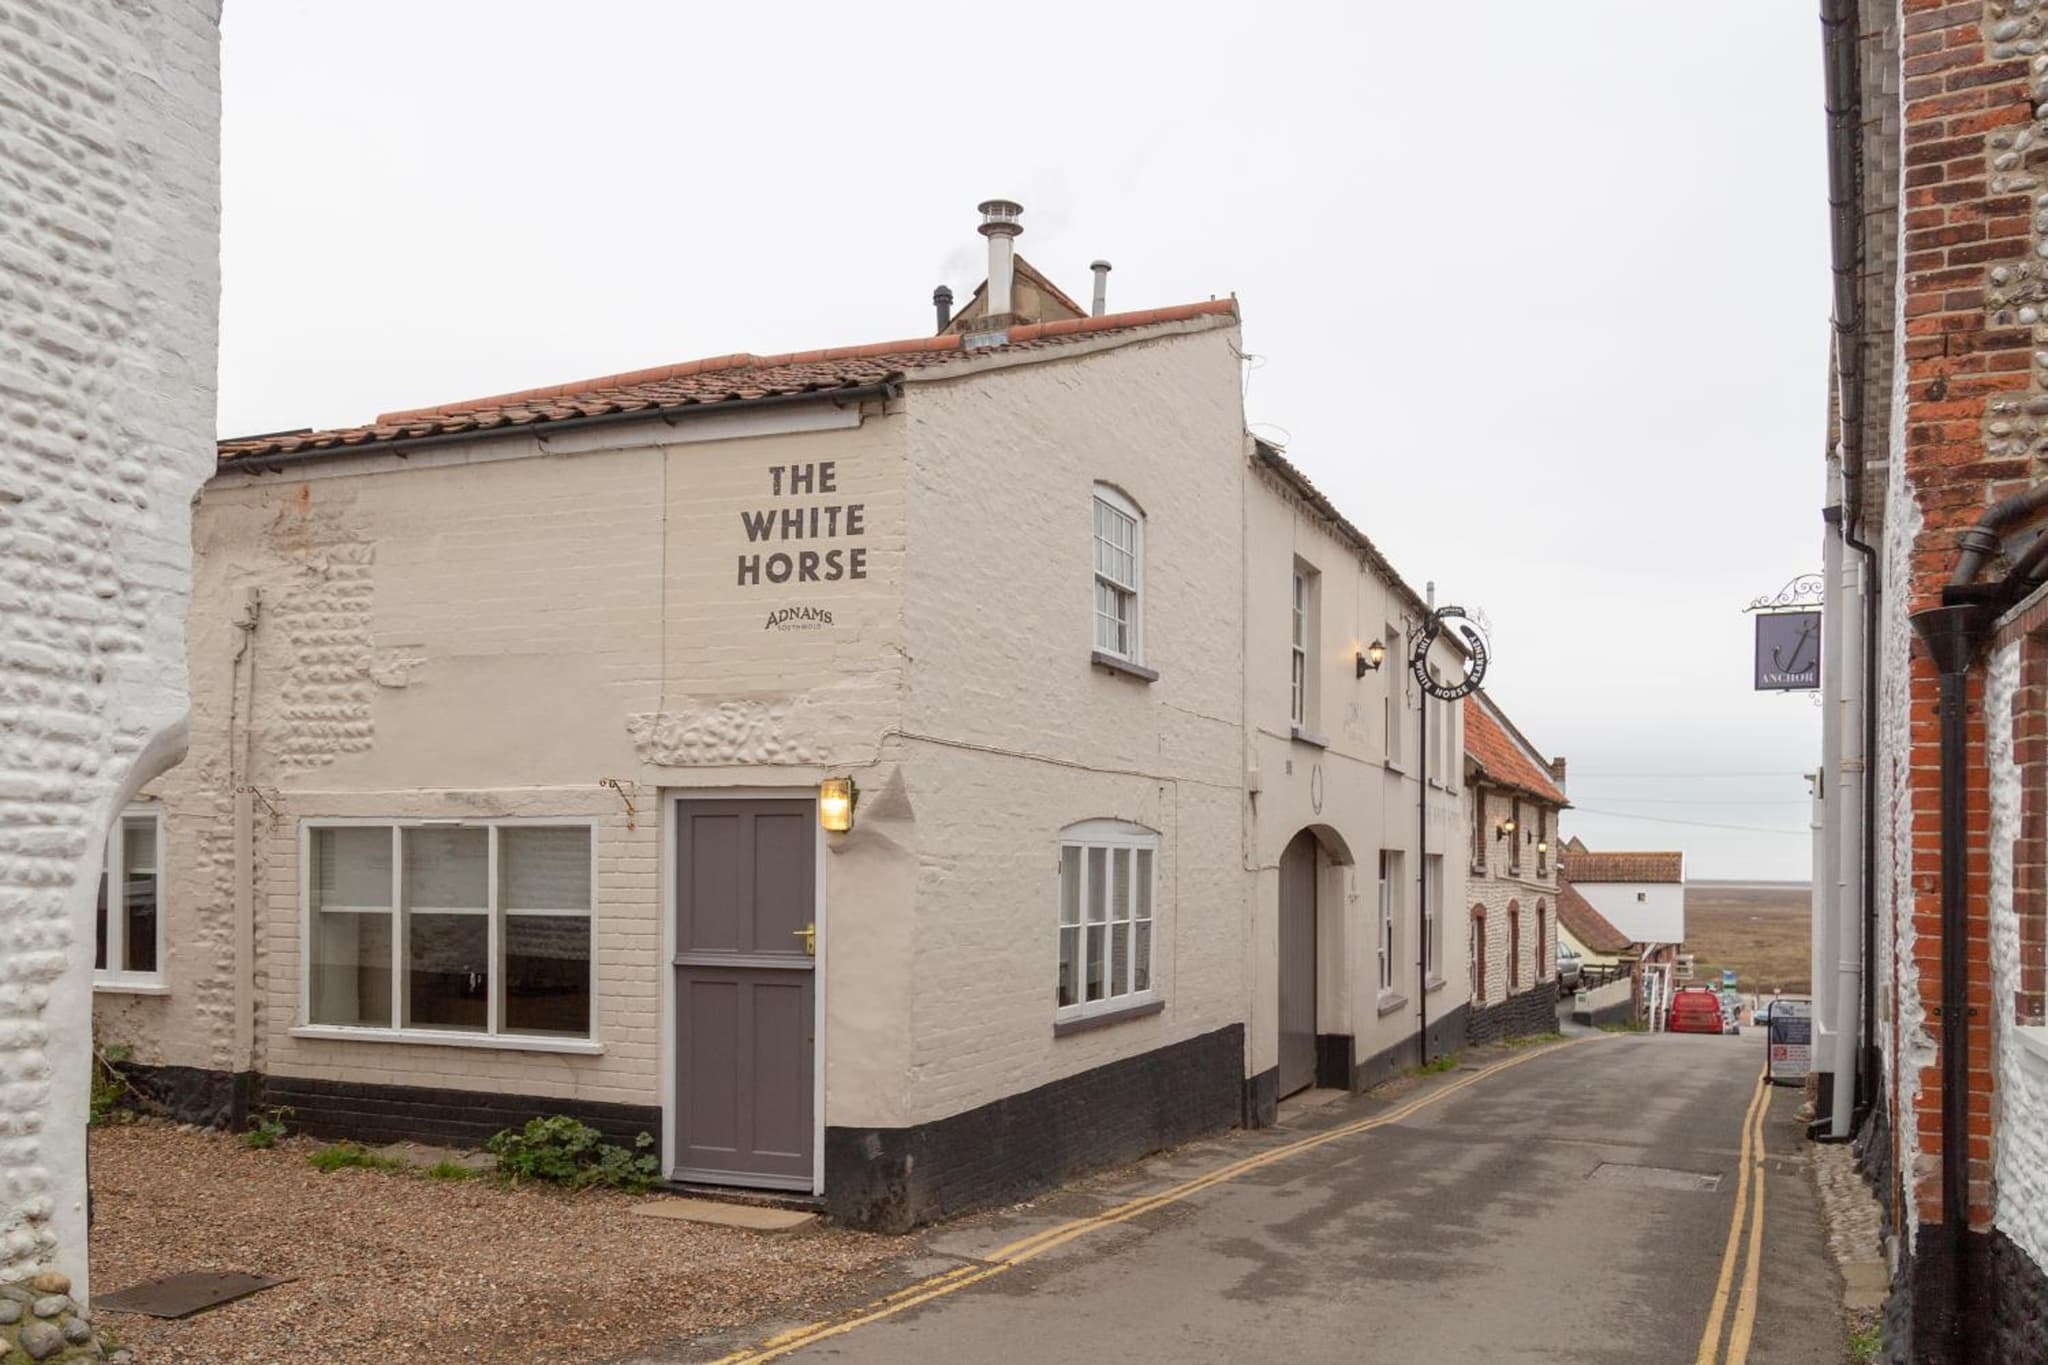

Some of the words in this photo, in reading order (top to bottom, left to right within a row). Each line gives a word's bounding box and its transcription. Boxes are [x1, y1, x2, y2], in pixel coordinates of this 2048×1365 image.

[769, 461, 836, 496] THE
[741, 504, 864, 542] WHITE
[737, 548, 866, 585] HORSE
[765, 606, 833, 629] ADNAMS
[1418, 637, 1431, 653] THE
[1470, 636, 1483, 683] BLAKENEY
[1415, 660, 1432, 689] WHITE
[1763, 672, 1813, 683] ANCHOR
[1434, 684, 1469, 698] HORSE
